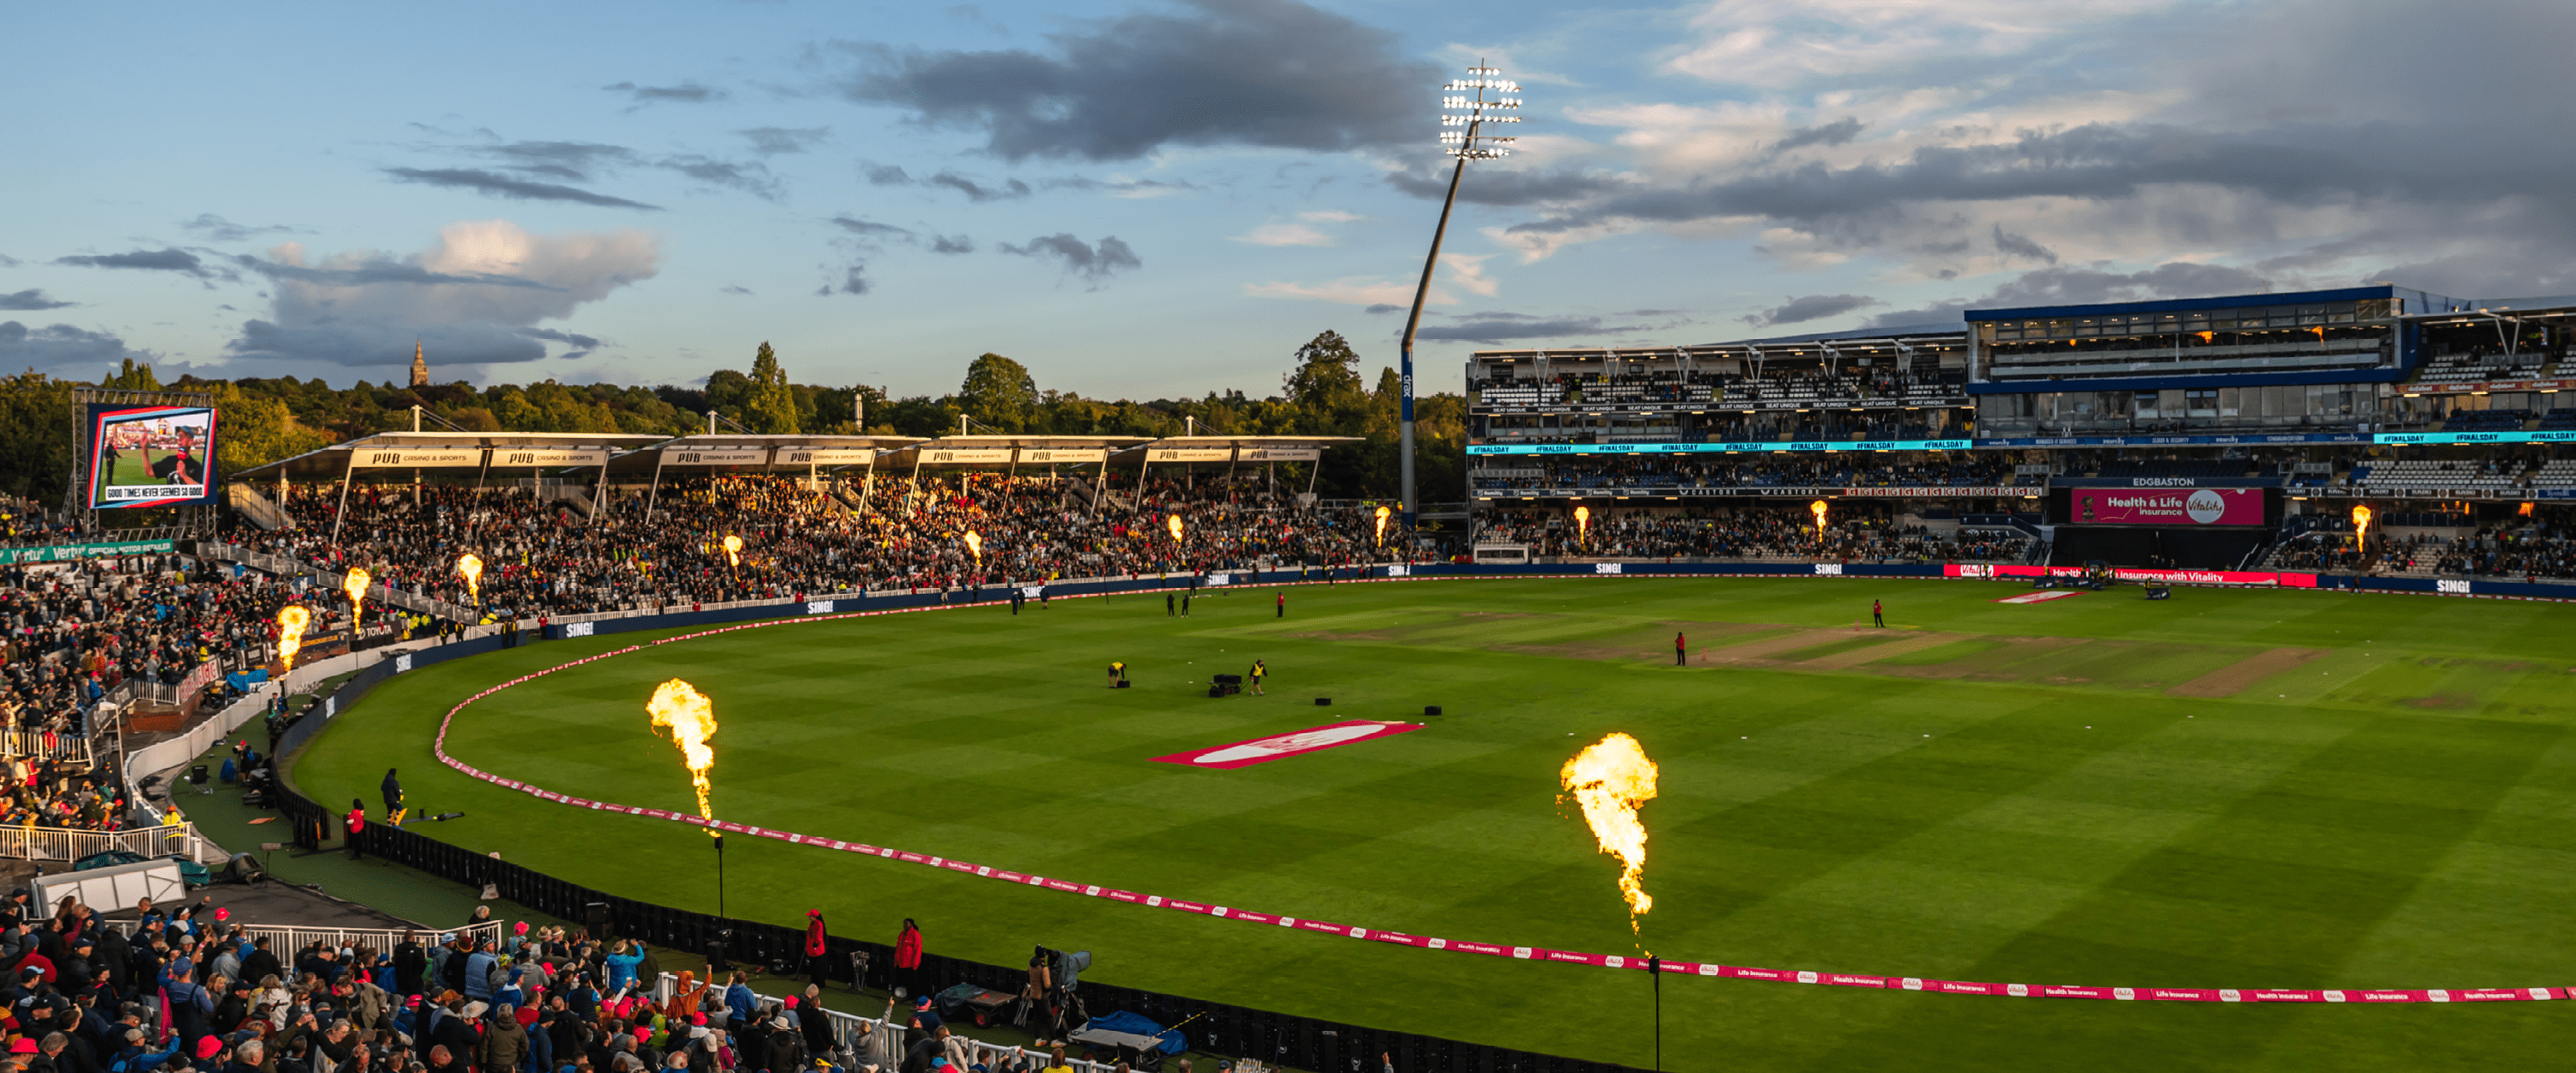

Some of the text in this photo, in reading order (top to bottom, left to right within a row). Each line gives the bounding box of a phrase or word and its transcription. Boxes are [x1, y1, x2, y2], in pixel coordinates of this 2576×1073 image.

[1403, 374, 1412, 397] drax
[373, 453, 400, 464] PUB
[509, 452, 534, 464] PUB
[677, 452, 701, 463] PUB
[791, 452, 811, 463] PUB
[933, 452, 953, 461] PUB
[1032, 452, 1051, 461] PUB
[1160, 451, 1178, 460] PUB
[1251, 451, 1268, 459] PUB
[2133, 478, 2195, 487] EDGBASTON
[107, 487, 203, 498] GOOD TIMES NEVER SEEMED SO GOOD
[2108, 497, 2183, 507] Health & Life
[2188, 498, 2223, 515] Vitality
[1595, 561, 1622, 574] SING!
[1815, 563, 1842, 575] SING!
[1208, 573, 1230, 585] SING!
[2166, 571, 2187, 581] with
[2189, 573, 2223, 582] Vitality
[2436, 579, 2470, 593] SING!
[808, 600, 834, 614] SING!
[566, 621, 594, 638] SING!
[1904, 979, 1922, 988] Vitality
